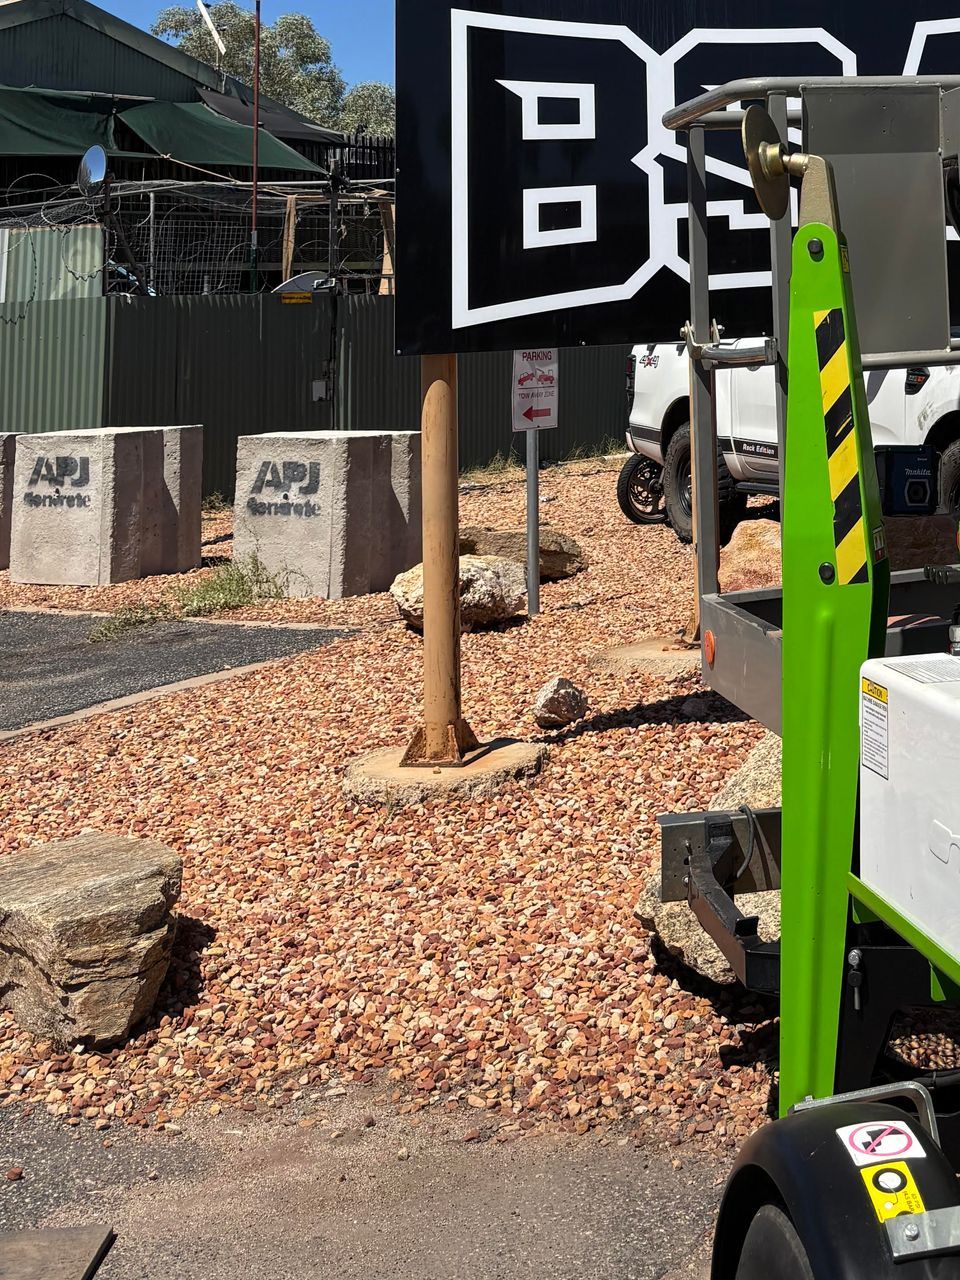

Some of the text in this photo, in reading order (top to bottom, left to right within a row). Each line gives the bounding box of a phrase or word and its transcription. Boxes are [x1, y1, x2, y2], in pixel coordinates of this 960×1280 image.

[521, 351, 553, 362] PARKING
[27, 456, 90, 488] APJ
[250, 460, 321, 495] APJ
